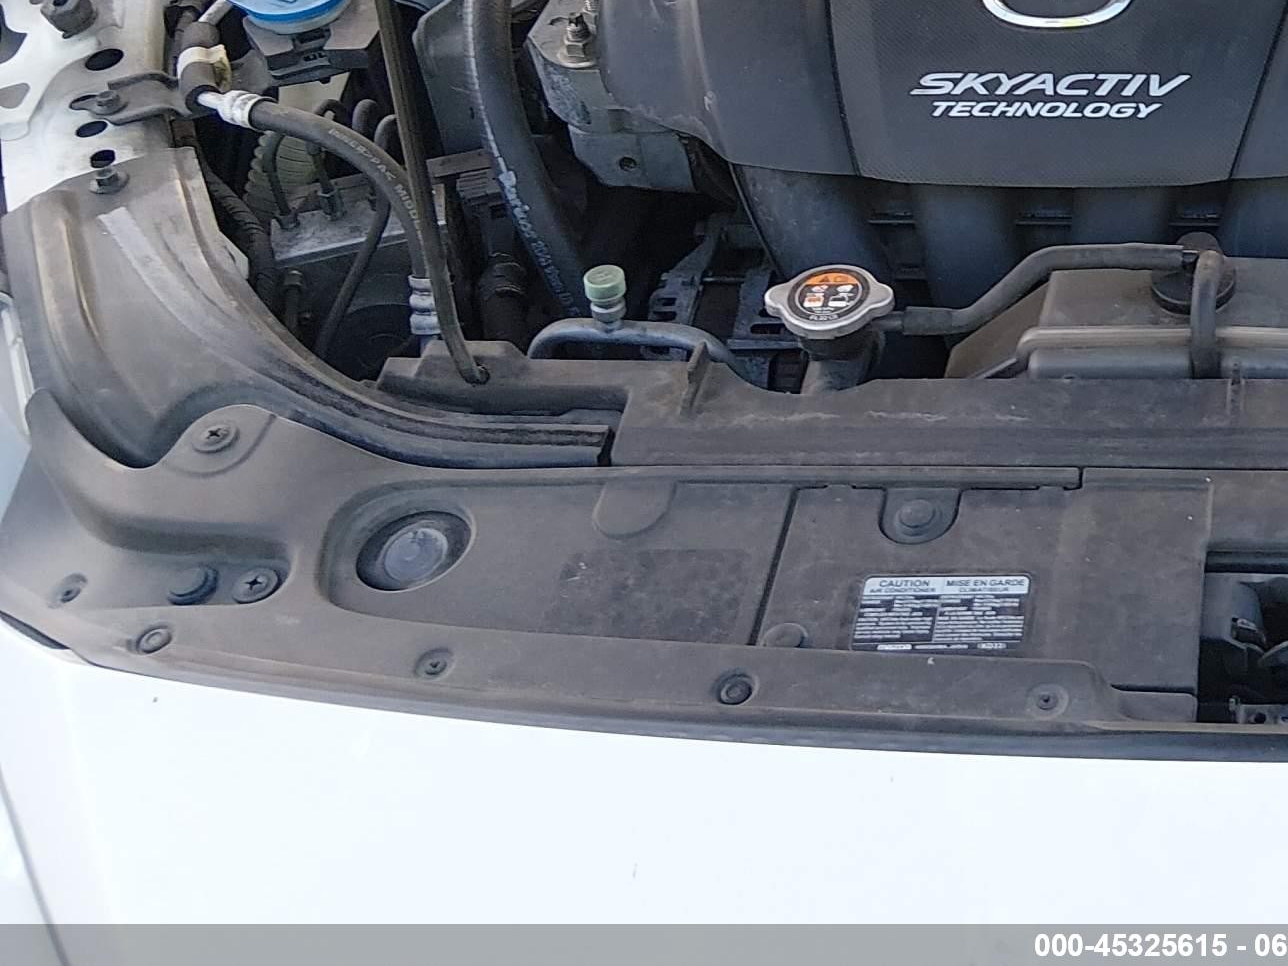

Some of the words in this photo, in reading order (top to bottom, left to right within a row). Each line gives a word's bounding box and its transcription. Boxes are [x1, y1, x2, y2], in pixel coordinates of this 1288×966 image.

[909, 72, 1191, 97] SKYACTIV
[931, 101, 1163, 119] TECHNOLOGY
[879, 579, 930, 587] CAUTION
